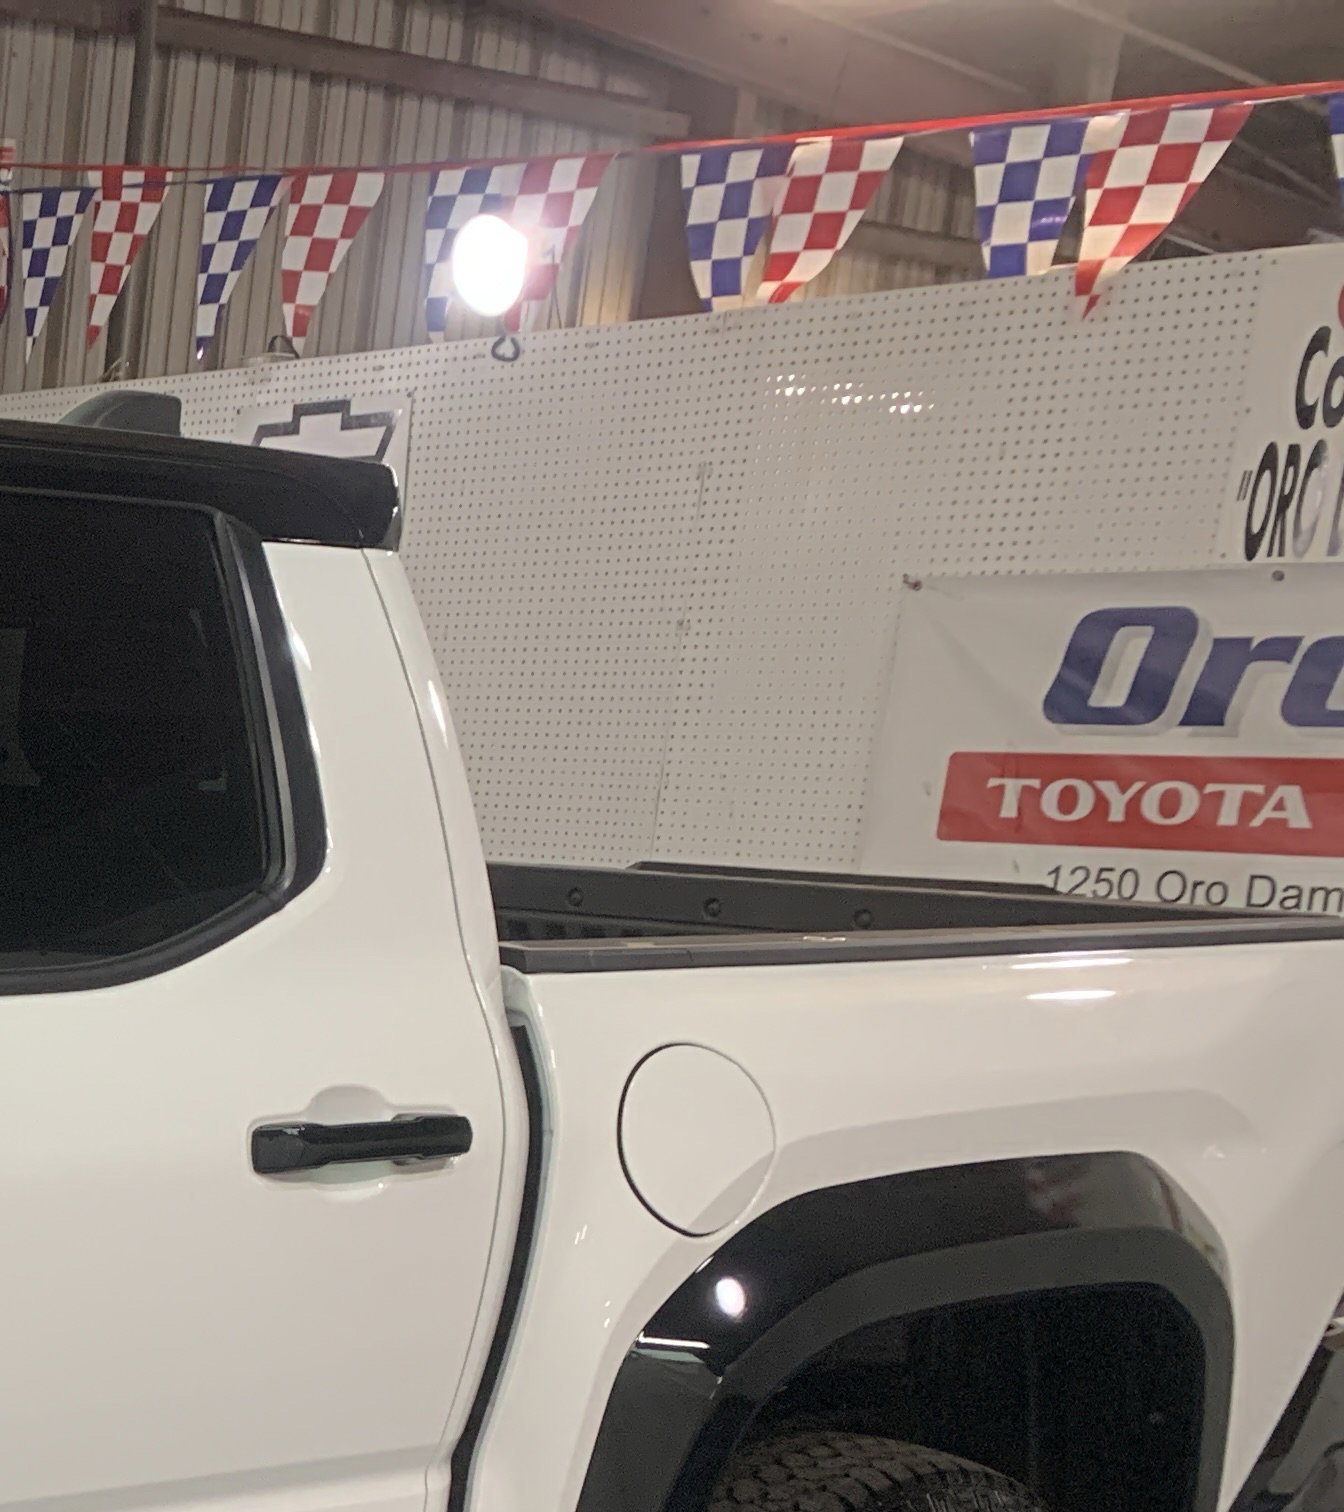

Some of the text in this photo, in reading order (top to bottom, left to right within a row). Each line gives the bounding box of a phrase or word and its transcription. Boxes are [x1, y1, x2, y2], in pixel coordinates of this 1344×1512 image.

[987, 776, 1313, 829] TOYOTA
[1046, 864, 1140, 900] 1250
[1156, 870, 1229, 906] Oro
